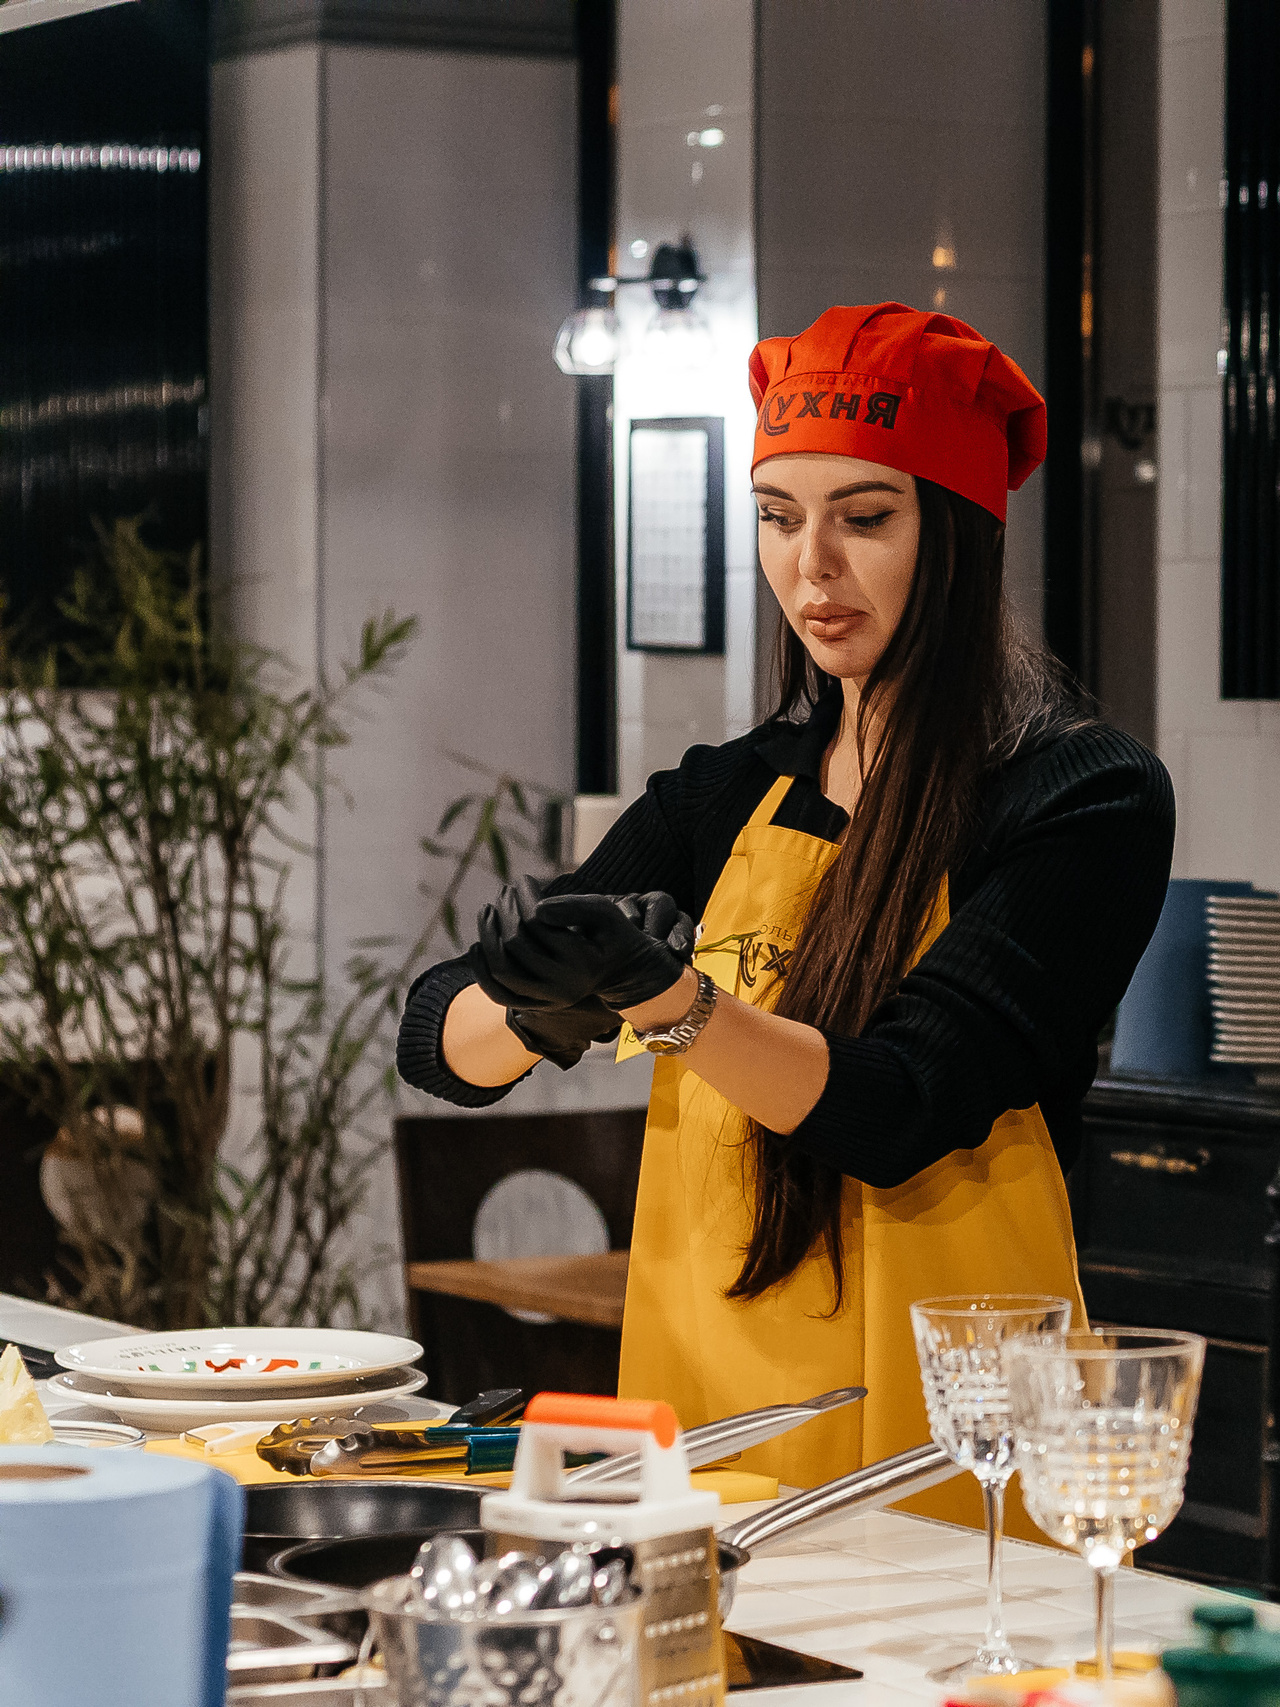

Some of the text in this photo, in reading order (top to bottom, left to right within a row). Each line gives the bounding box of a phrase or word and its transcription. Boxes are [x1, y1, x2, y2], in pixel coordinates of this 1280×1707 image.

[758, 391, 901, 437] КУХНЯ
[758, 924, 793, 942] ОЛЬ
[738, 938, 795, 988] КУХ
